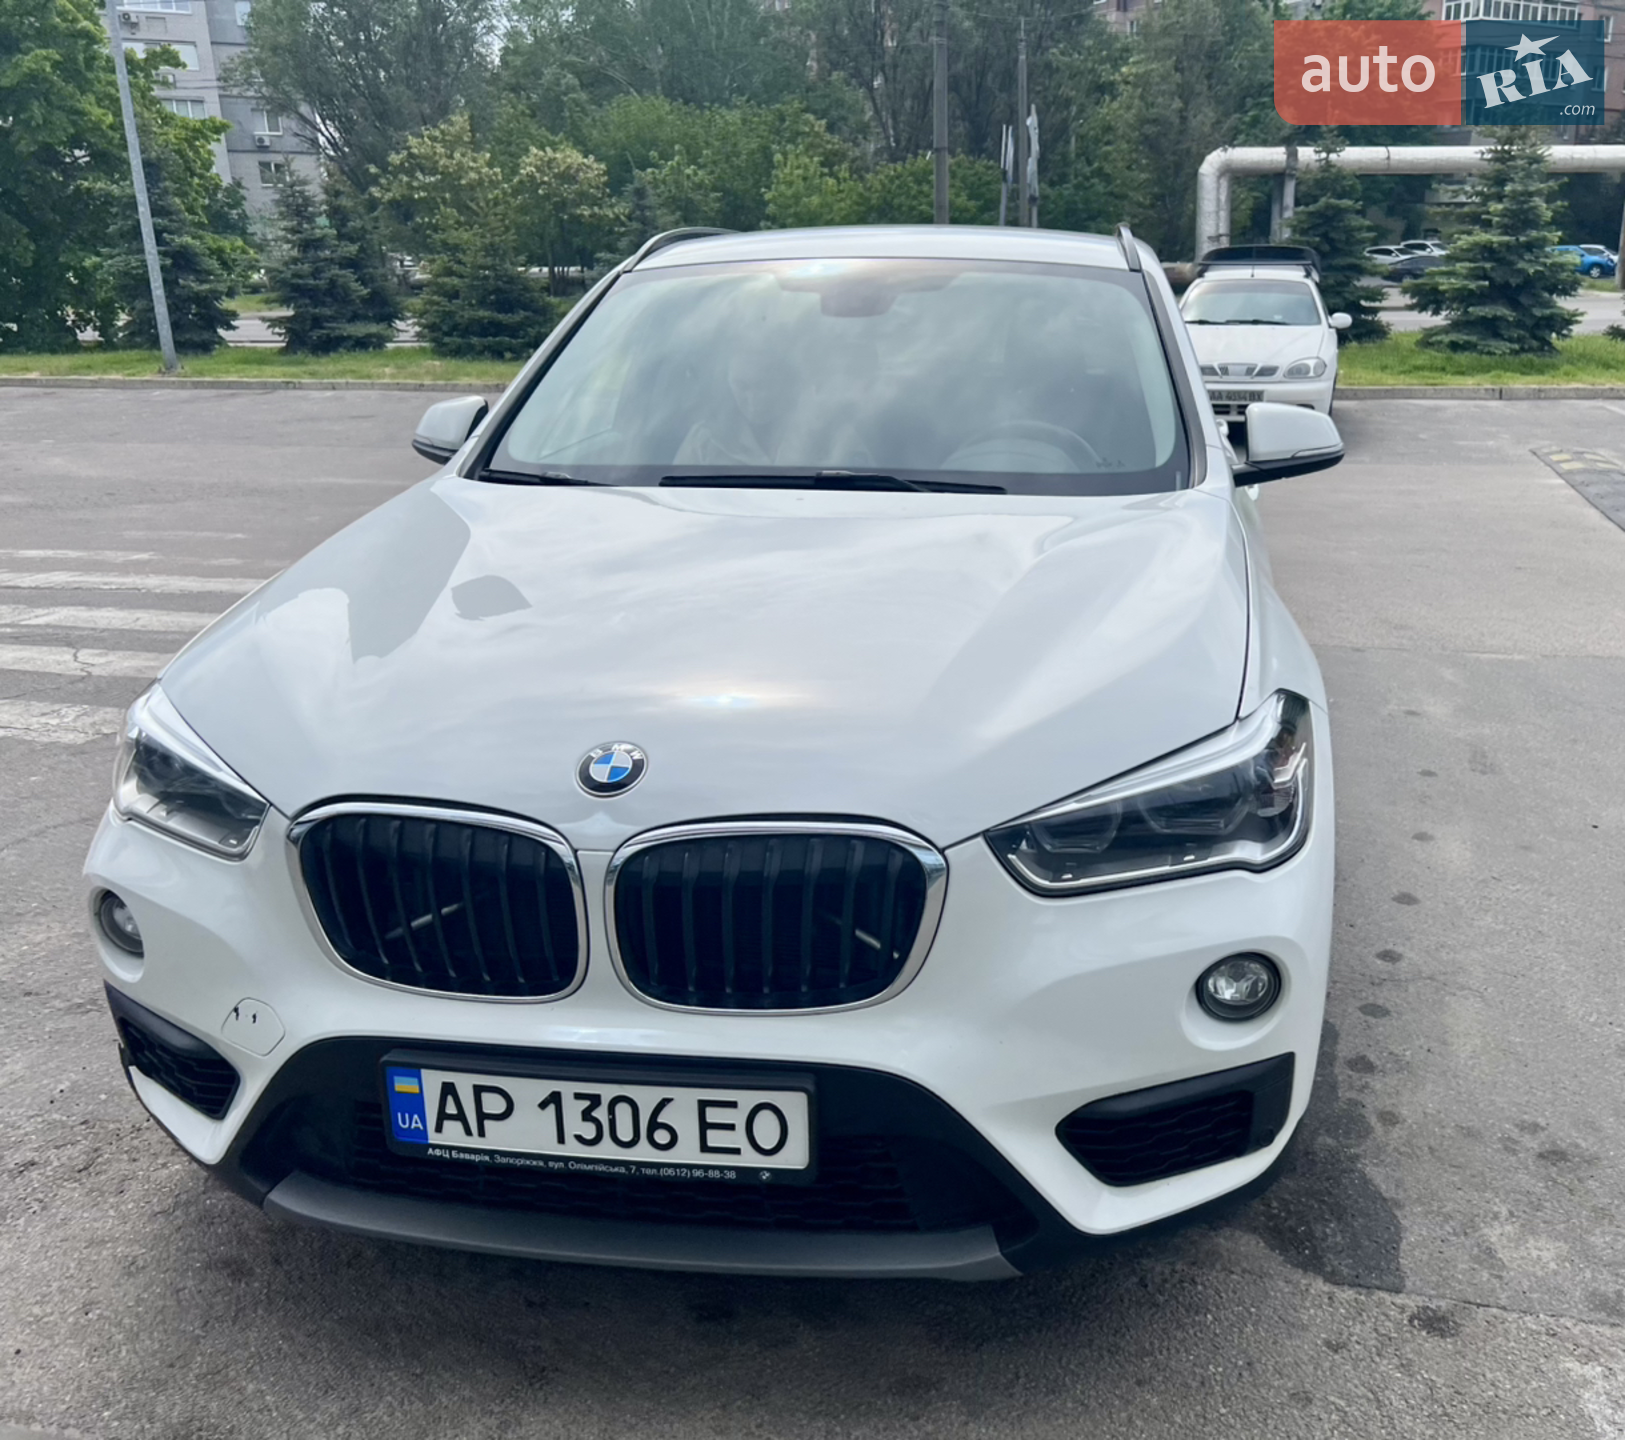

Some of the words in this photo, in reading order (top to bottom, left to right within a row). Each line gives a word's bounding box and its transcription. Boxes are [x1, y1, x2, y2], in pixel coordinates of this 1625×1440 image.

[397, 1112, 424, 1130] UA
[434, 1081, 515, 1138] AP
[536, 1090, 679, 1151] 1306
[697, 1098, 789, 1156] EO
[427, 1147, 450, 1159] АФЦ
